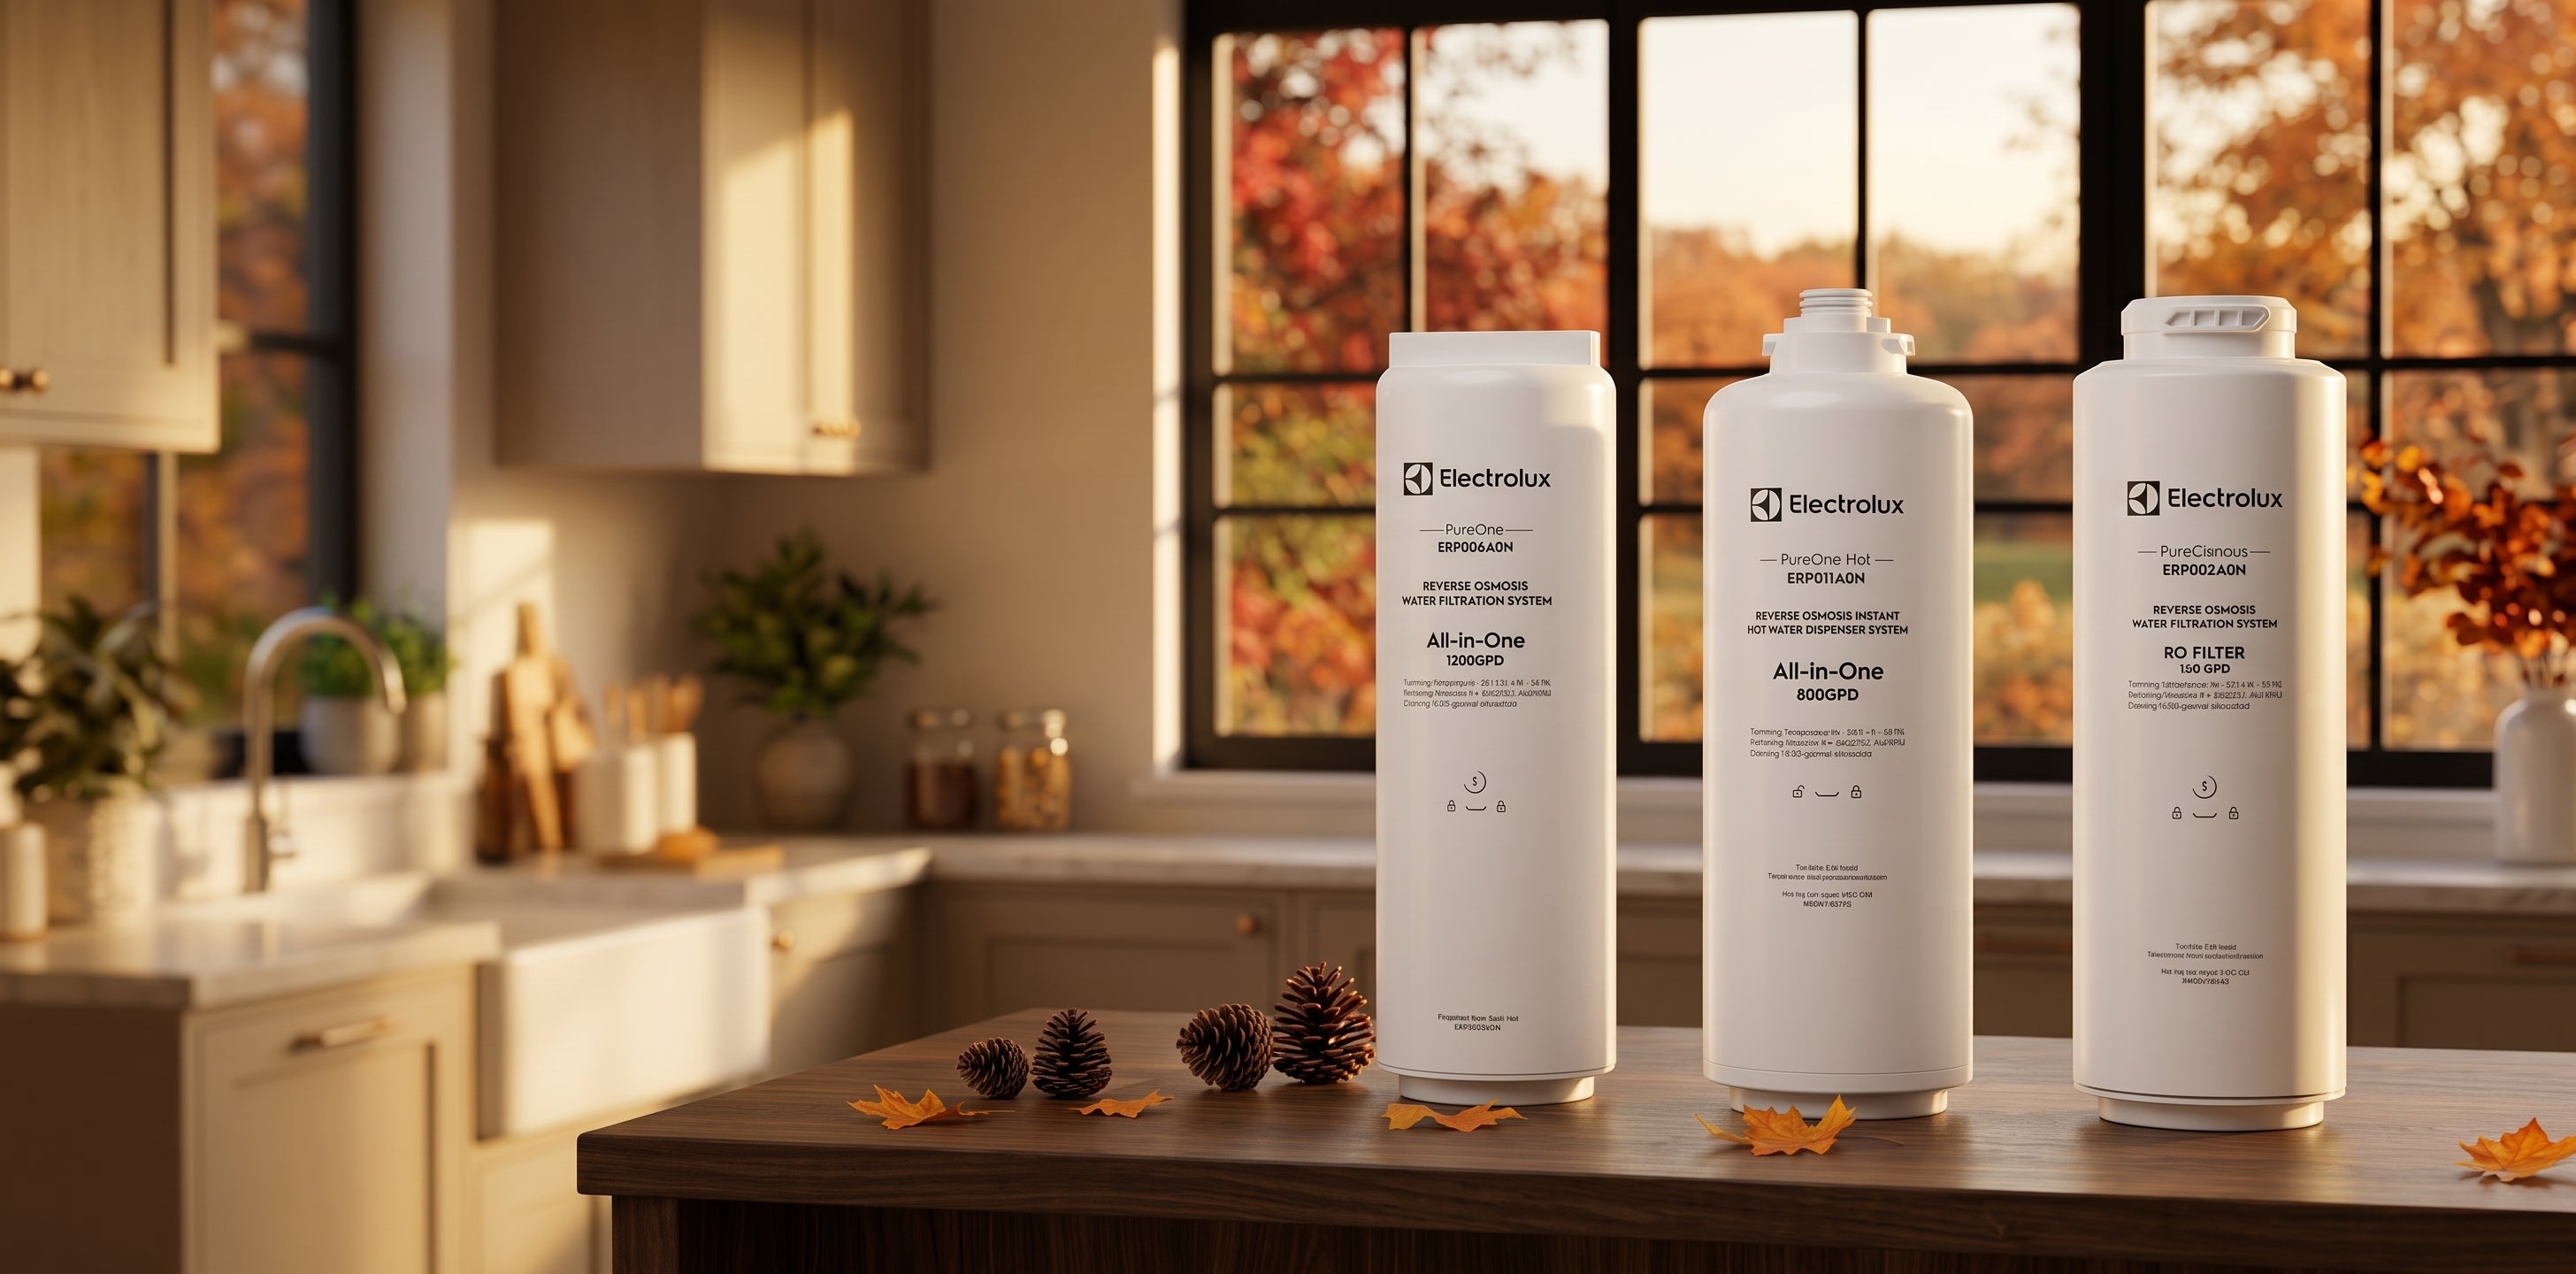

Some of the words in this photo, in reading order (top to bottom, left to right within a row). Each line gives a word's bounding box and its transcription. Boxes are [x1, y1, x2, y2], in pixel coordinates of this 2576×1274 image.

[1439, 468, 1552, 488] Electrolux
[2167, 487, 2283, 508] Electrolux
[1790, 494, 1905, 515] Electrolux
[1445, 523, 1505, 536] PureOne
[1438, 541, 1514, 553] ERP006A0N
[1781, 553, 1842, 566] PureOne
[1846, 553, 1871, 566] Hot
[2162, 563, 2246, 576] ERP002A0N
[1787, 572, 1866, 585] ERP011A0N
[1422, 580, 1472, 592] REVERSE
[1474, 580, 1529, 592] OSMOSIS
[1401, 595, 1437, 606] WATER
[1438, 595, 1505, 606] FILTRATION
[1506, 595, 1552, 606] SYSTEM
[1755, 610, 1800, 621] REVERSE
[1802, 610, 1853, 621] OSMOSIS
[1855, 610, 1901, 621] INSTANT
[2153, 604, 2203, 615] REVERSE
[2204, 604, 2257, 615] OSMOSIS
[1747, 625, 1767, 635] HOT
[1767, 625, 1804, 635] WATER
[1806, 625, 1867, 635] DISPENSER
[1867, 625, 1909, 635] SYSTEM
[2132, 618, 2167, 629] WATER
[2170, 618, 2235, 629] FILTRATION
[2236, 618, 2278, 629] SYSTEM
[1426, 631, 1526, 649] All-in-One
[2164, 645, 2188, 660] RO
[2192, 646, 2245, 660] FILTER
[1445, 654, 1505, 667] 1200GPD
[1772, 661, 1884, 680] All-in-One
[2203, 663, 2231, 674] GPD
[1796, 687, 1859, 702] 800GPD
